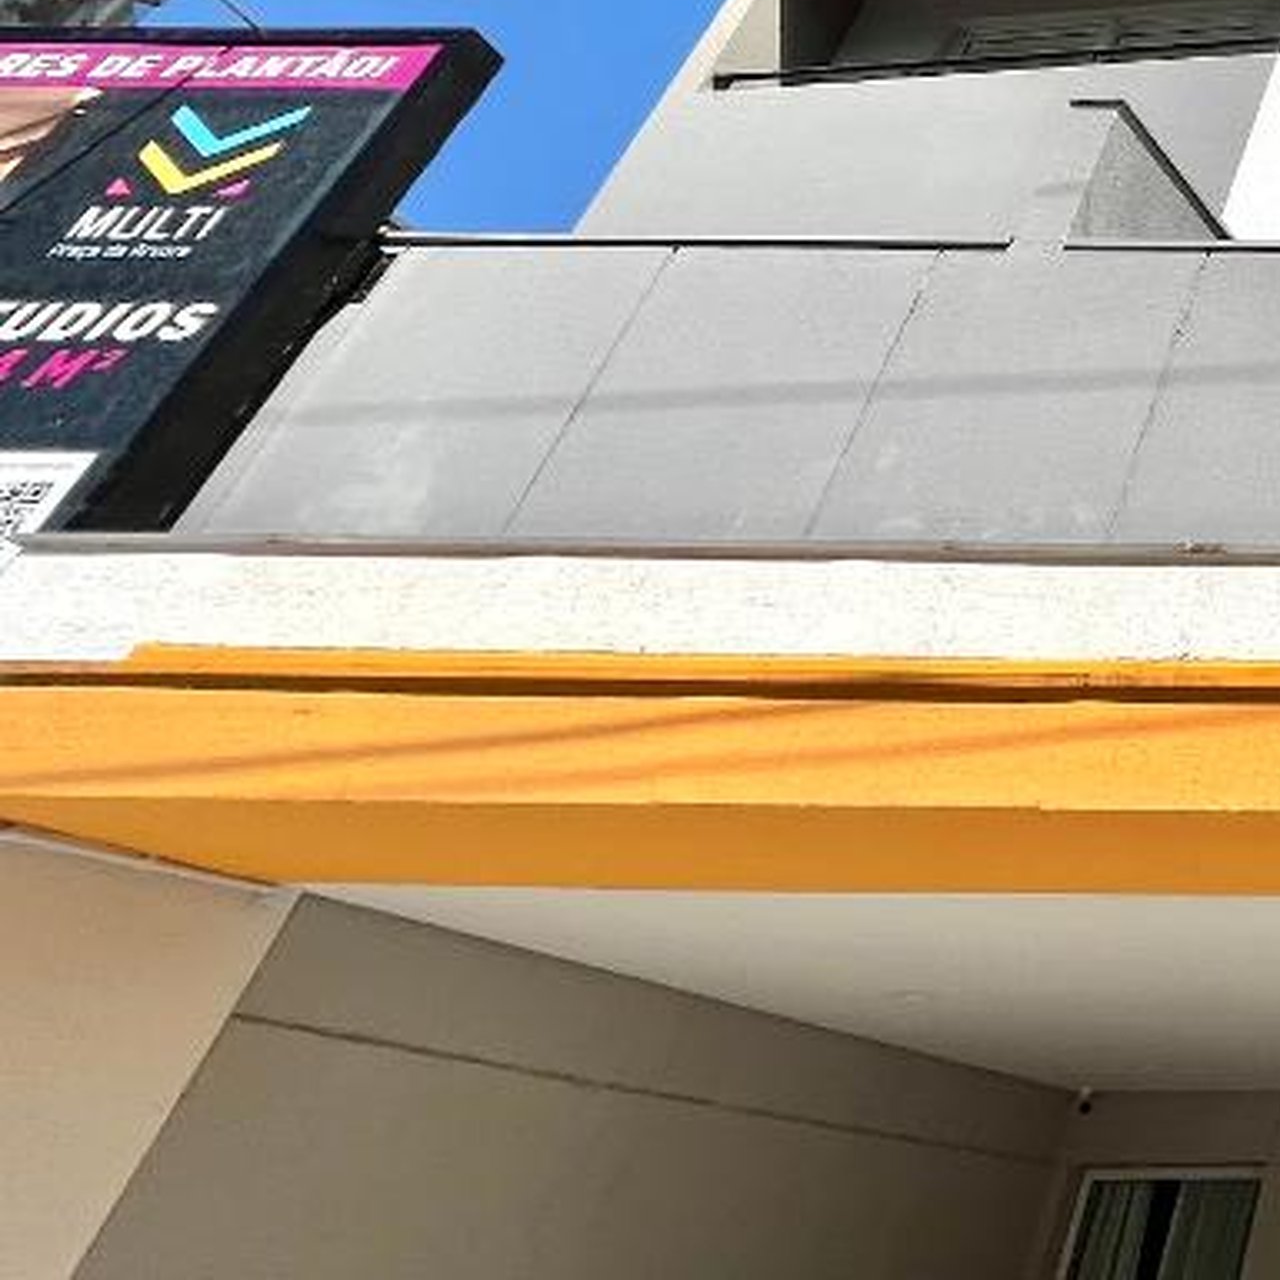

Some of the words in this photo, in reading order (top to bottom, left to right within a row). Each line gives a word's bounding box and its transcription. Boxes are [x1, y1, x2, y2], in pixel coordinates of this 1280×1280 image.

[87, 54, 163, 78] DE
[160, 48, 398, 78] PLANTÃO!
[63, 206, 229, 240] MULTI
